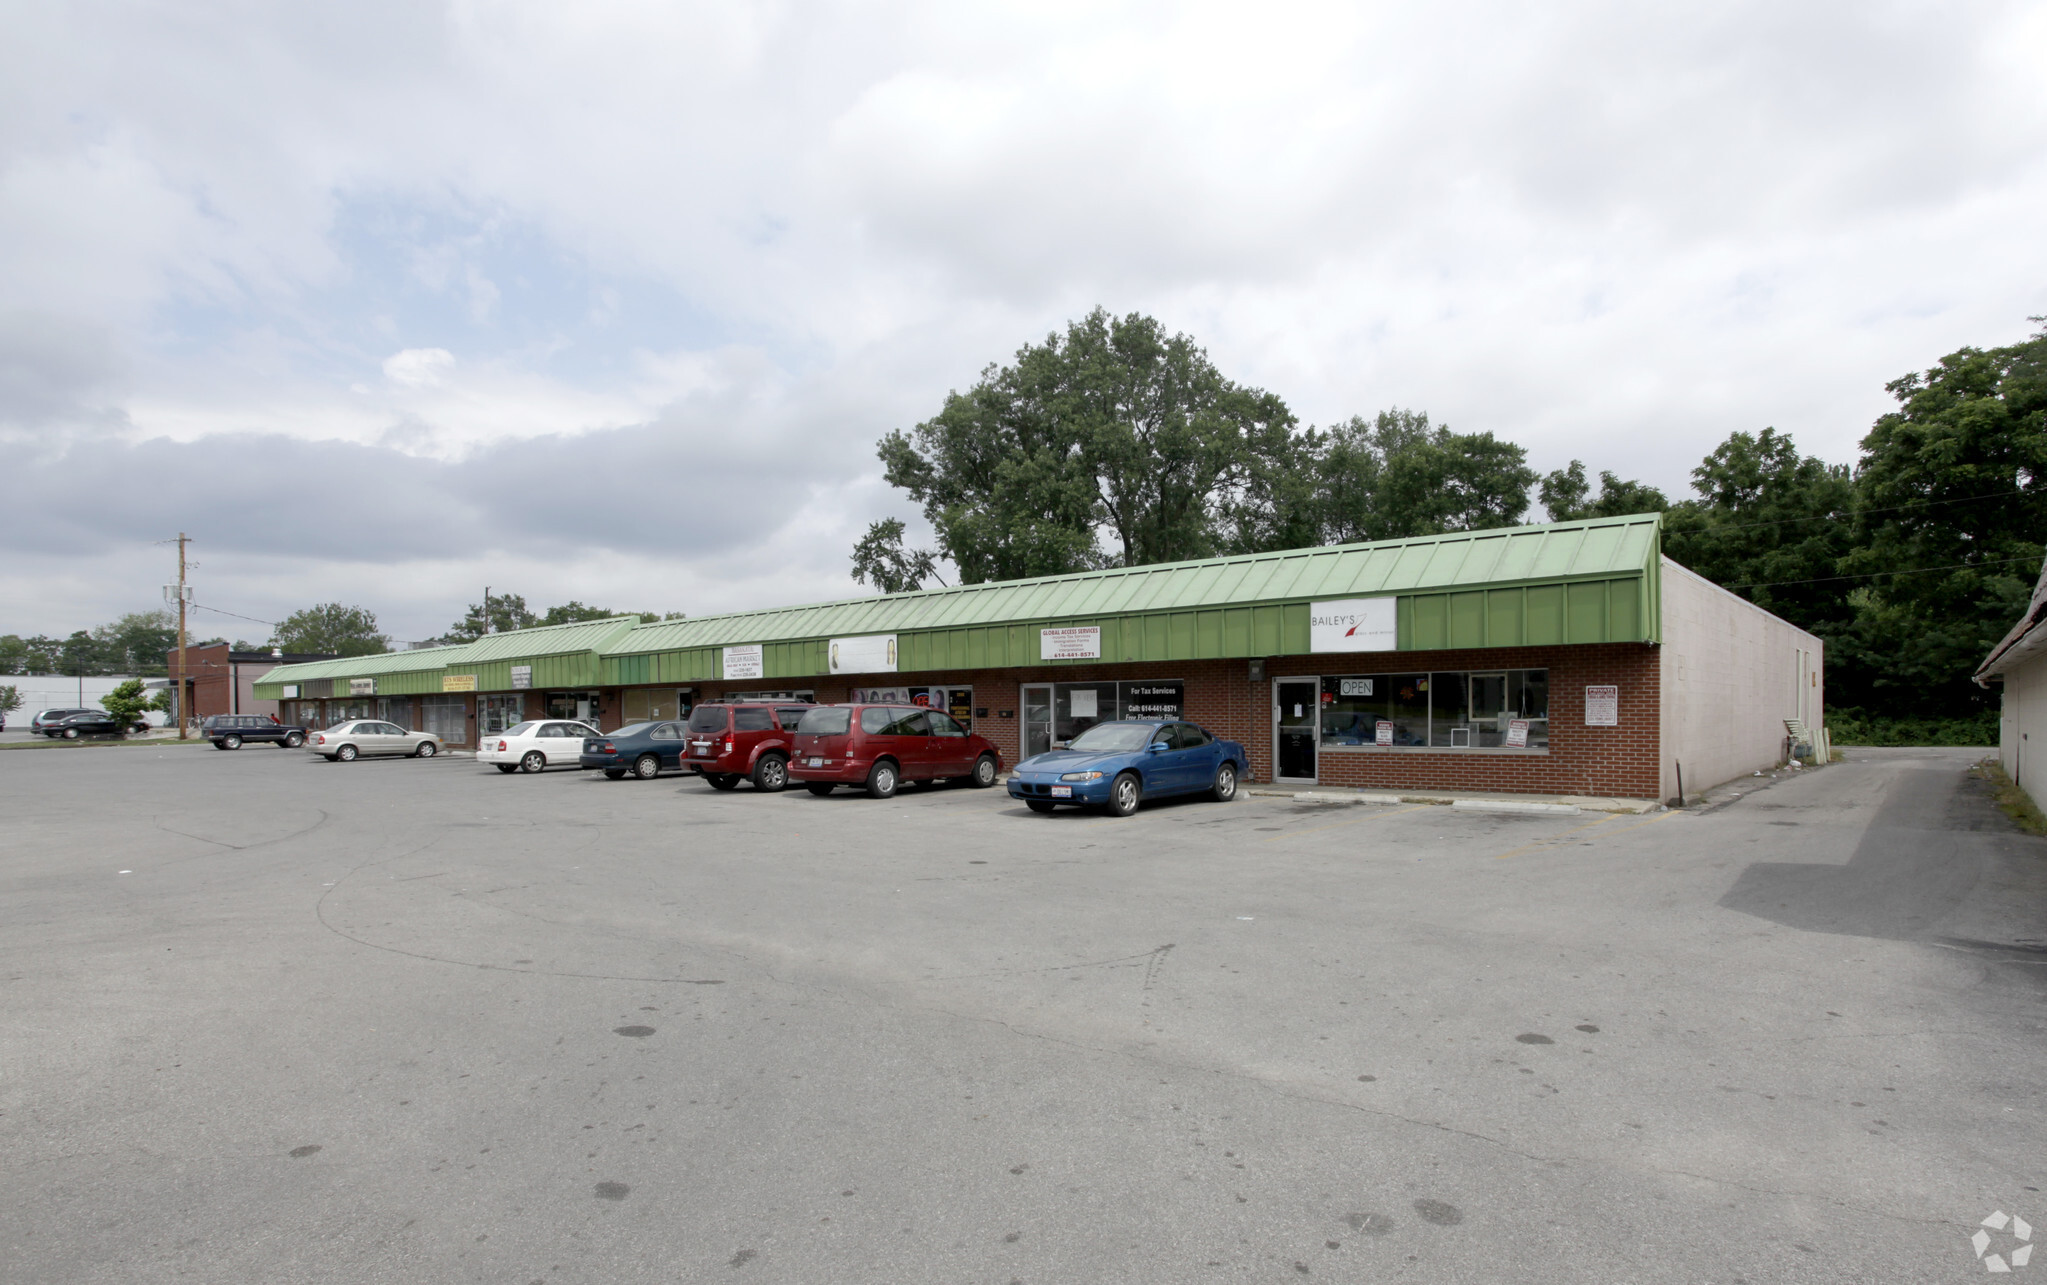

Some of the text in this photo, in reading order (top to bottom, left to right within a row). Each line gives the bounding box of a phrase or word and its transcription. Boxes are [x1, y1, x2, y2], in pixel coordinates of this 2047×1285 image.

[1312, 615, 1355, 626] BAILEY'S
[1342, 681, 1371, 694] OPEN
[1141, 704, 1177, 712] 614-441-8571
